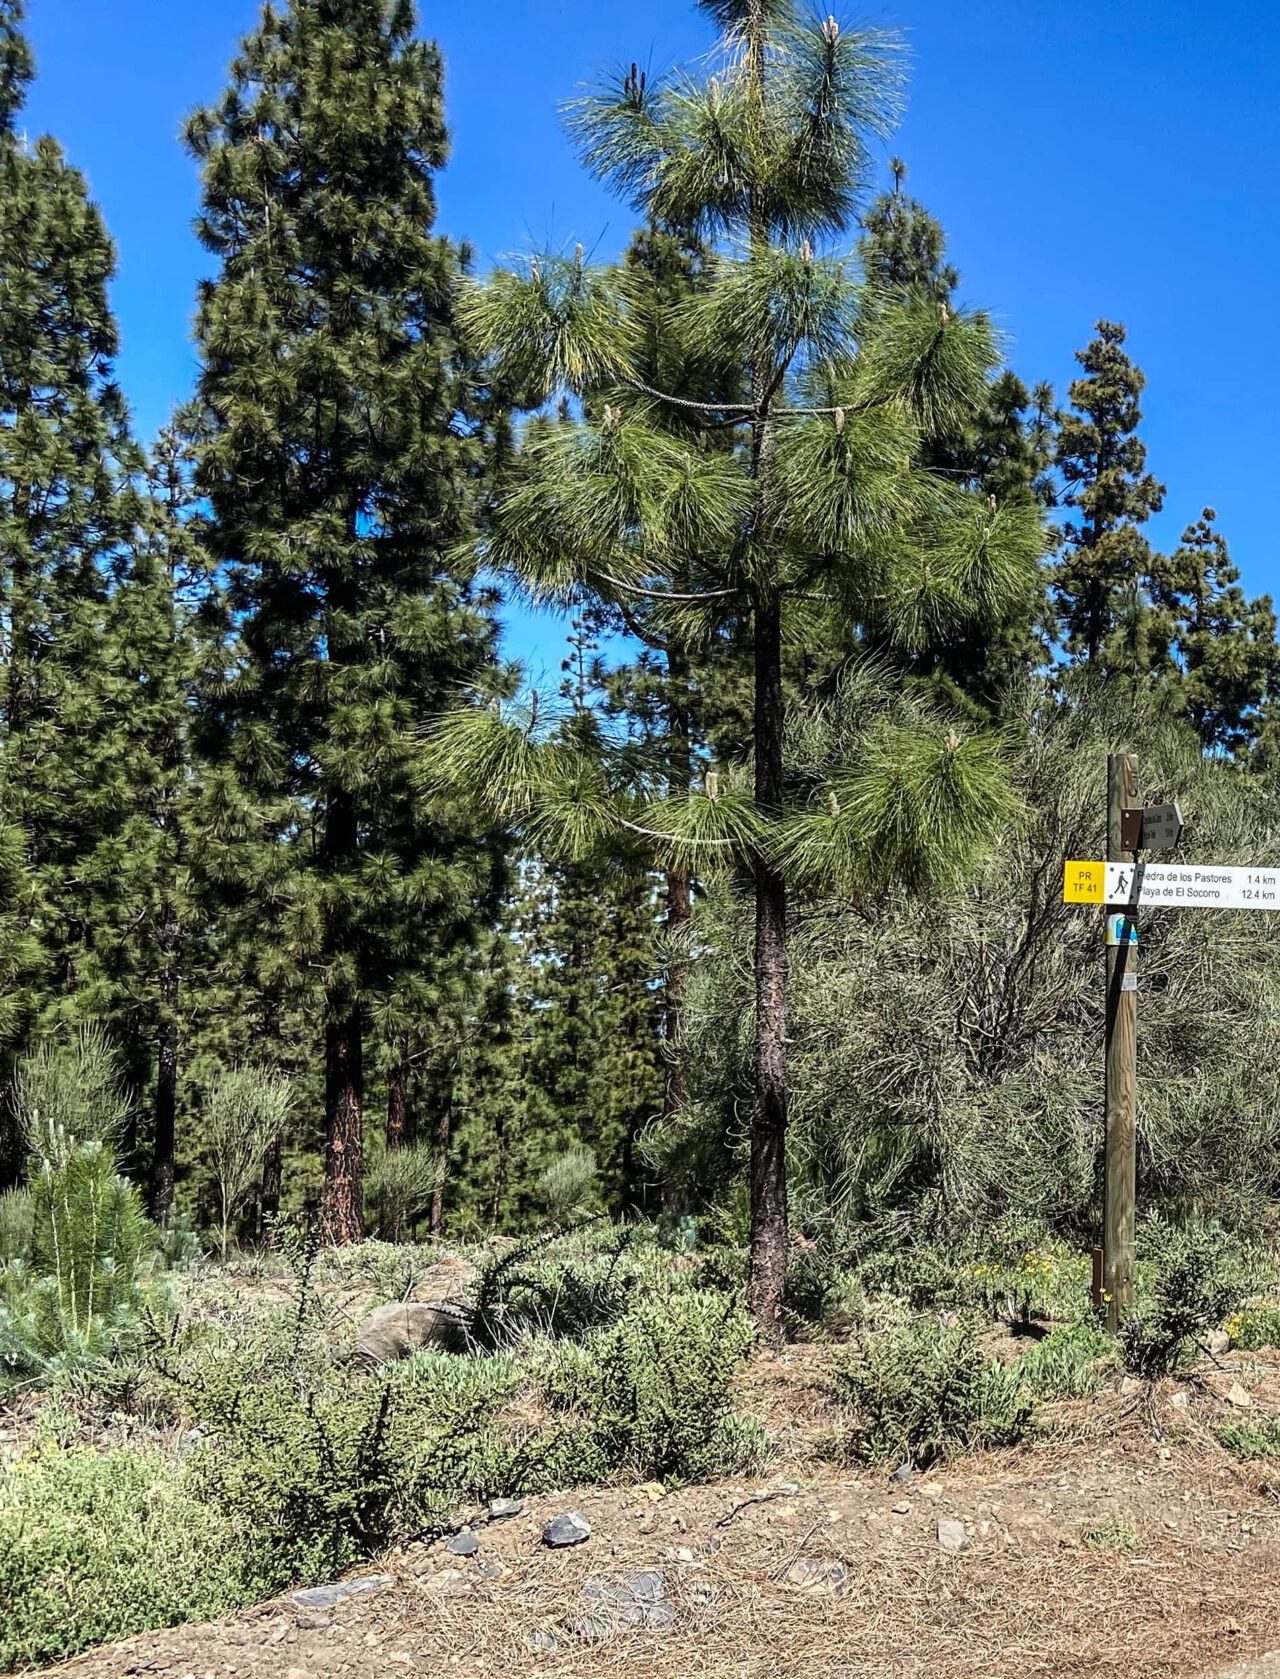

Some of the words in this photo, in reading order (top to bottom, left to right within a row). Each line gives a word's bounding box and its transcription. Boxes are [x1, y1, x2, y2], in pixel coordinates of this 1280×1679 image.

[1078, 871, 1092, 881] PR
[1167, 872, 1177, 882] de
[1180, 872, 1193, 882] los
[1194, 873, 1232, 884] Pastores
[1248, 875, 1260, 884] 1.4
[1263, 875, 1276, 885] km
[1073, 883, 1085, 892] TF
[1087, 884, 1097, 893] 41
[1136, 886, 1160, 898] Playa
[1163, 887, 1174, 897] de
[1176, 887, 1184, 897] El
[1186, 888, 1220, 898] Socorro
[1242, 890, 1260, 899] 12.4
[1262, 890, 1275, 900] km
